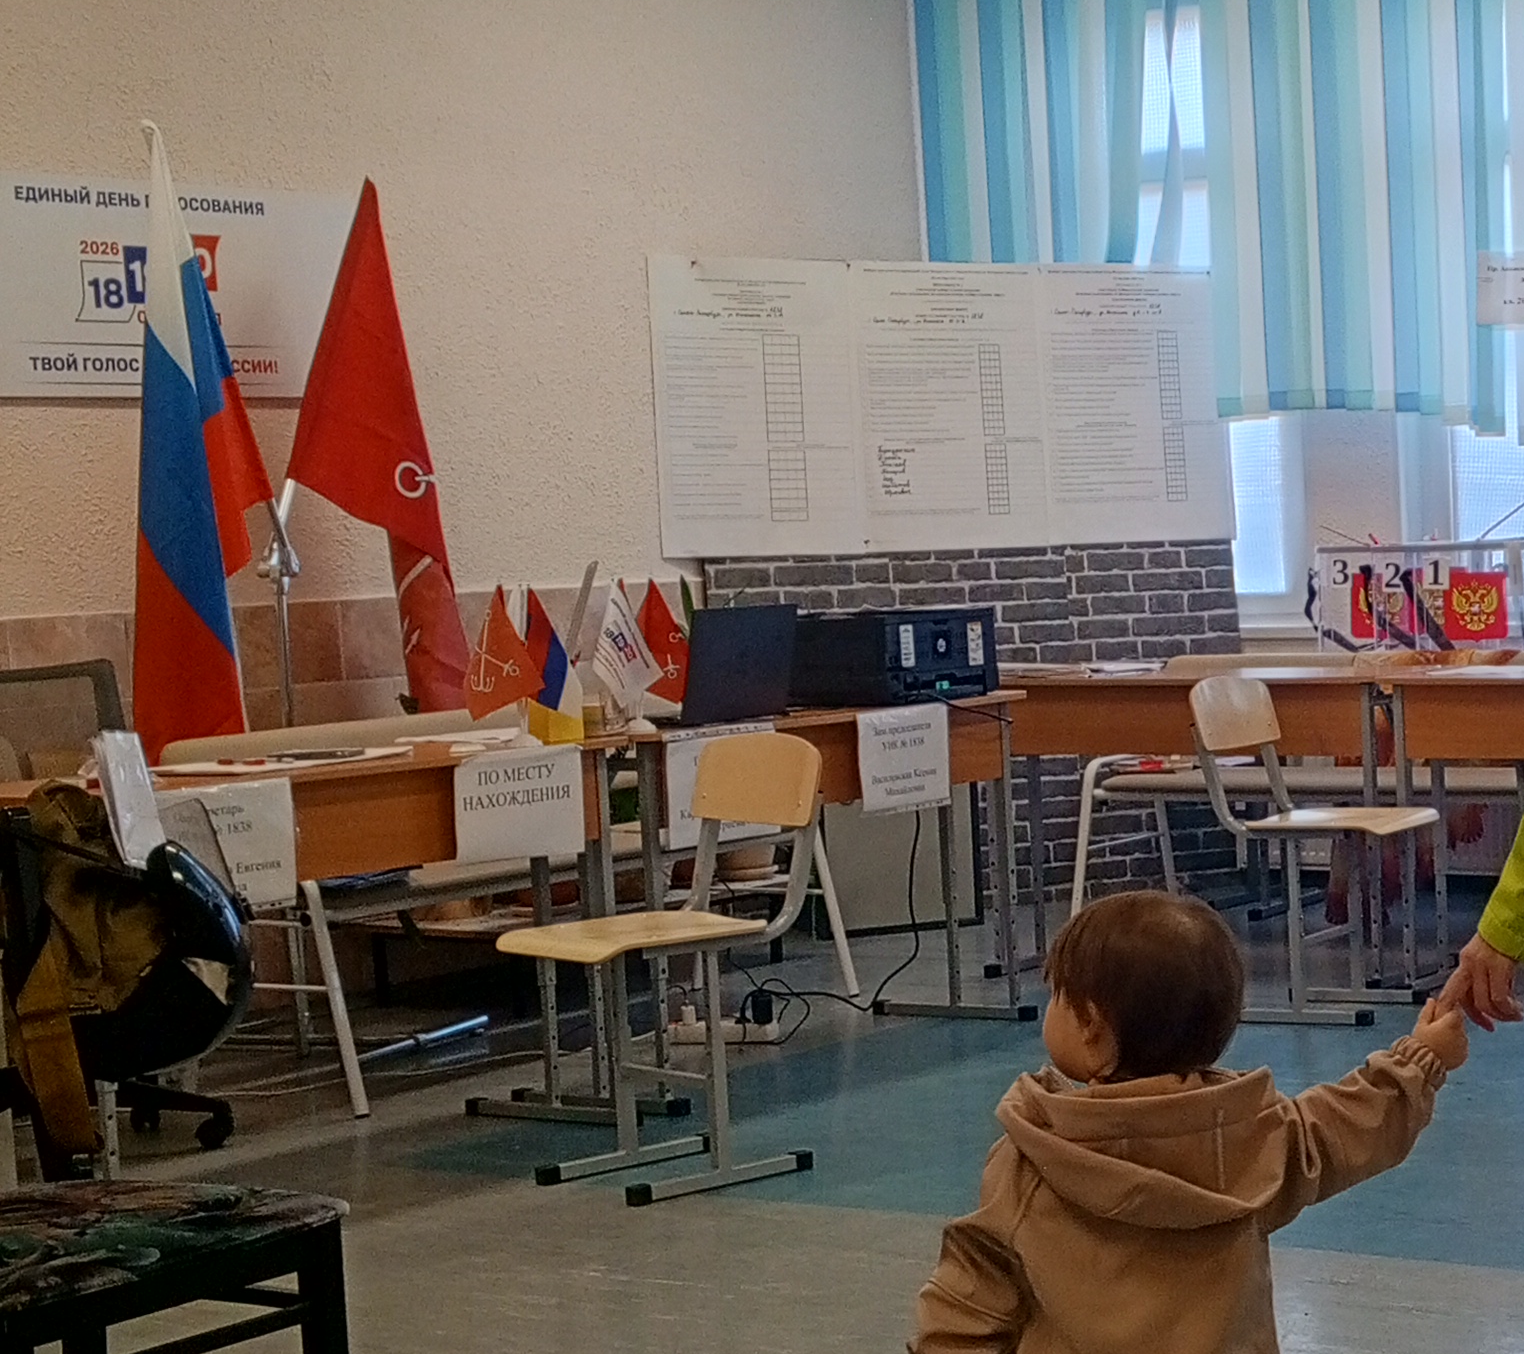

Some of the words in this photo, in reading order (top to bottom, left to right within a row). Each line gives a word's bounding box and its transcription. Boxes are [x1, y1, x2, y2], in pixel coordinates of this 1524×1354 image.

[14, 185, 91, 205] ЕДИНЫЙ
[95, 192, 141, 209] ДЕНЬ
[145, 194, 265, 217] ГОСОВАНИЯ
[80, 240, 120, 256] 2026
[87, 277, 124, 309] 18
[29, 353, 79, 372] ТВОЙ
[83, 356, 141, 373] ГОЛОС
[231, 359, 279, 374] ССИИ!
[1332, 559, 1350, 586] 3
[1384, 562, 1402, 589] 2
[1427, 559, 1445, 586] 1
[477, 769, 500, 786] ПО
[503, 763, 555, 784] МЕСТУ
[462, 784, 571, 812] НАХОЖДЕНИЯ
